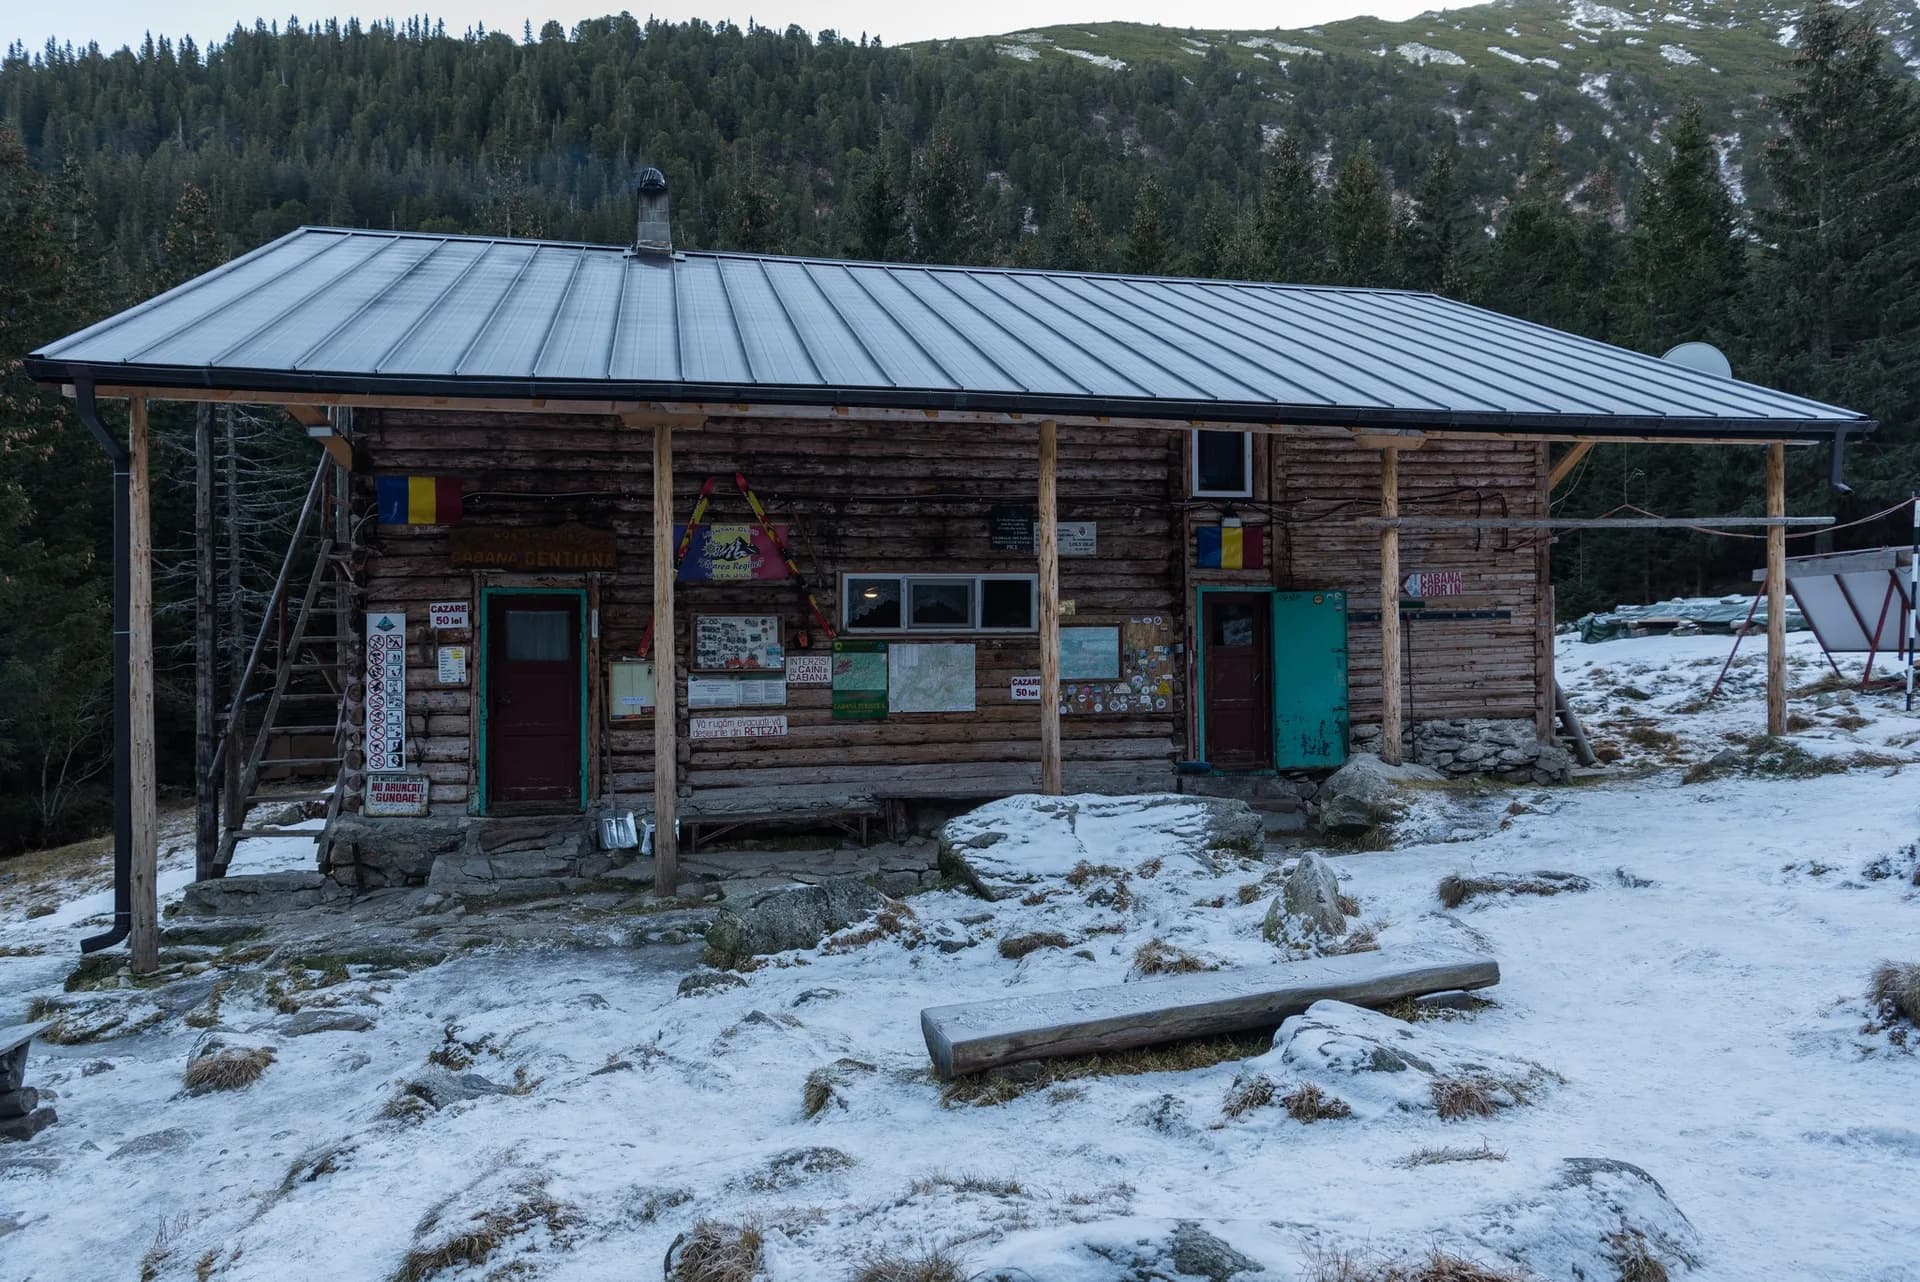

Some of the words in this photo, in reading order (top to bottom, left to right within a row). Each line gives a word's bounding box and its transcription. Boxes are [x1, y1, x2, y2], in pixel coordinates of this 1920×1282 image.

[451, 551, 518, 566] CABANA
[525, 551, 616, 568] GENTIANA
[1420, 571, 1461, 585] CABANA
[1420, 583, 1461, 597] CODRIN
[430, 605, 467, 613] CAZARE
[436, 616, 449, 625] 50
[451, 616, 462, 624] lei
[788, 673, 828, 682] CABANA
[1015, 688, 1027, 697] 50
[1028, 689, 1038, 697] lei
[744, 725, 784, 736] RETEZAT
[372, 782, 383, 792] NU
